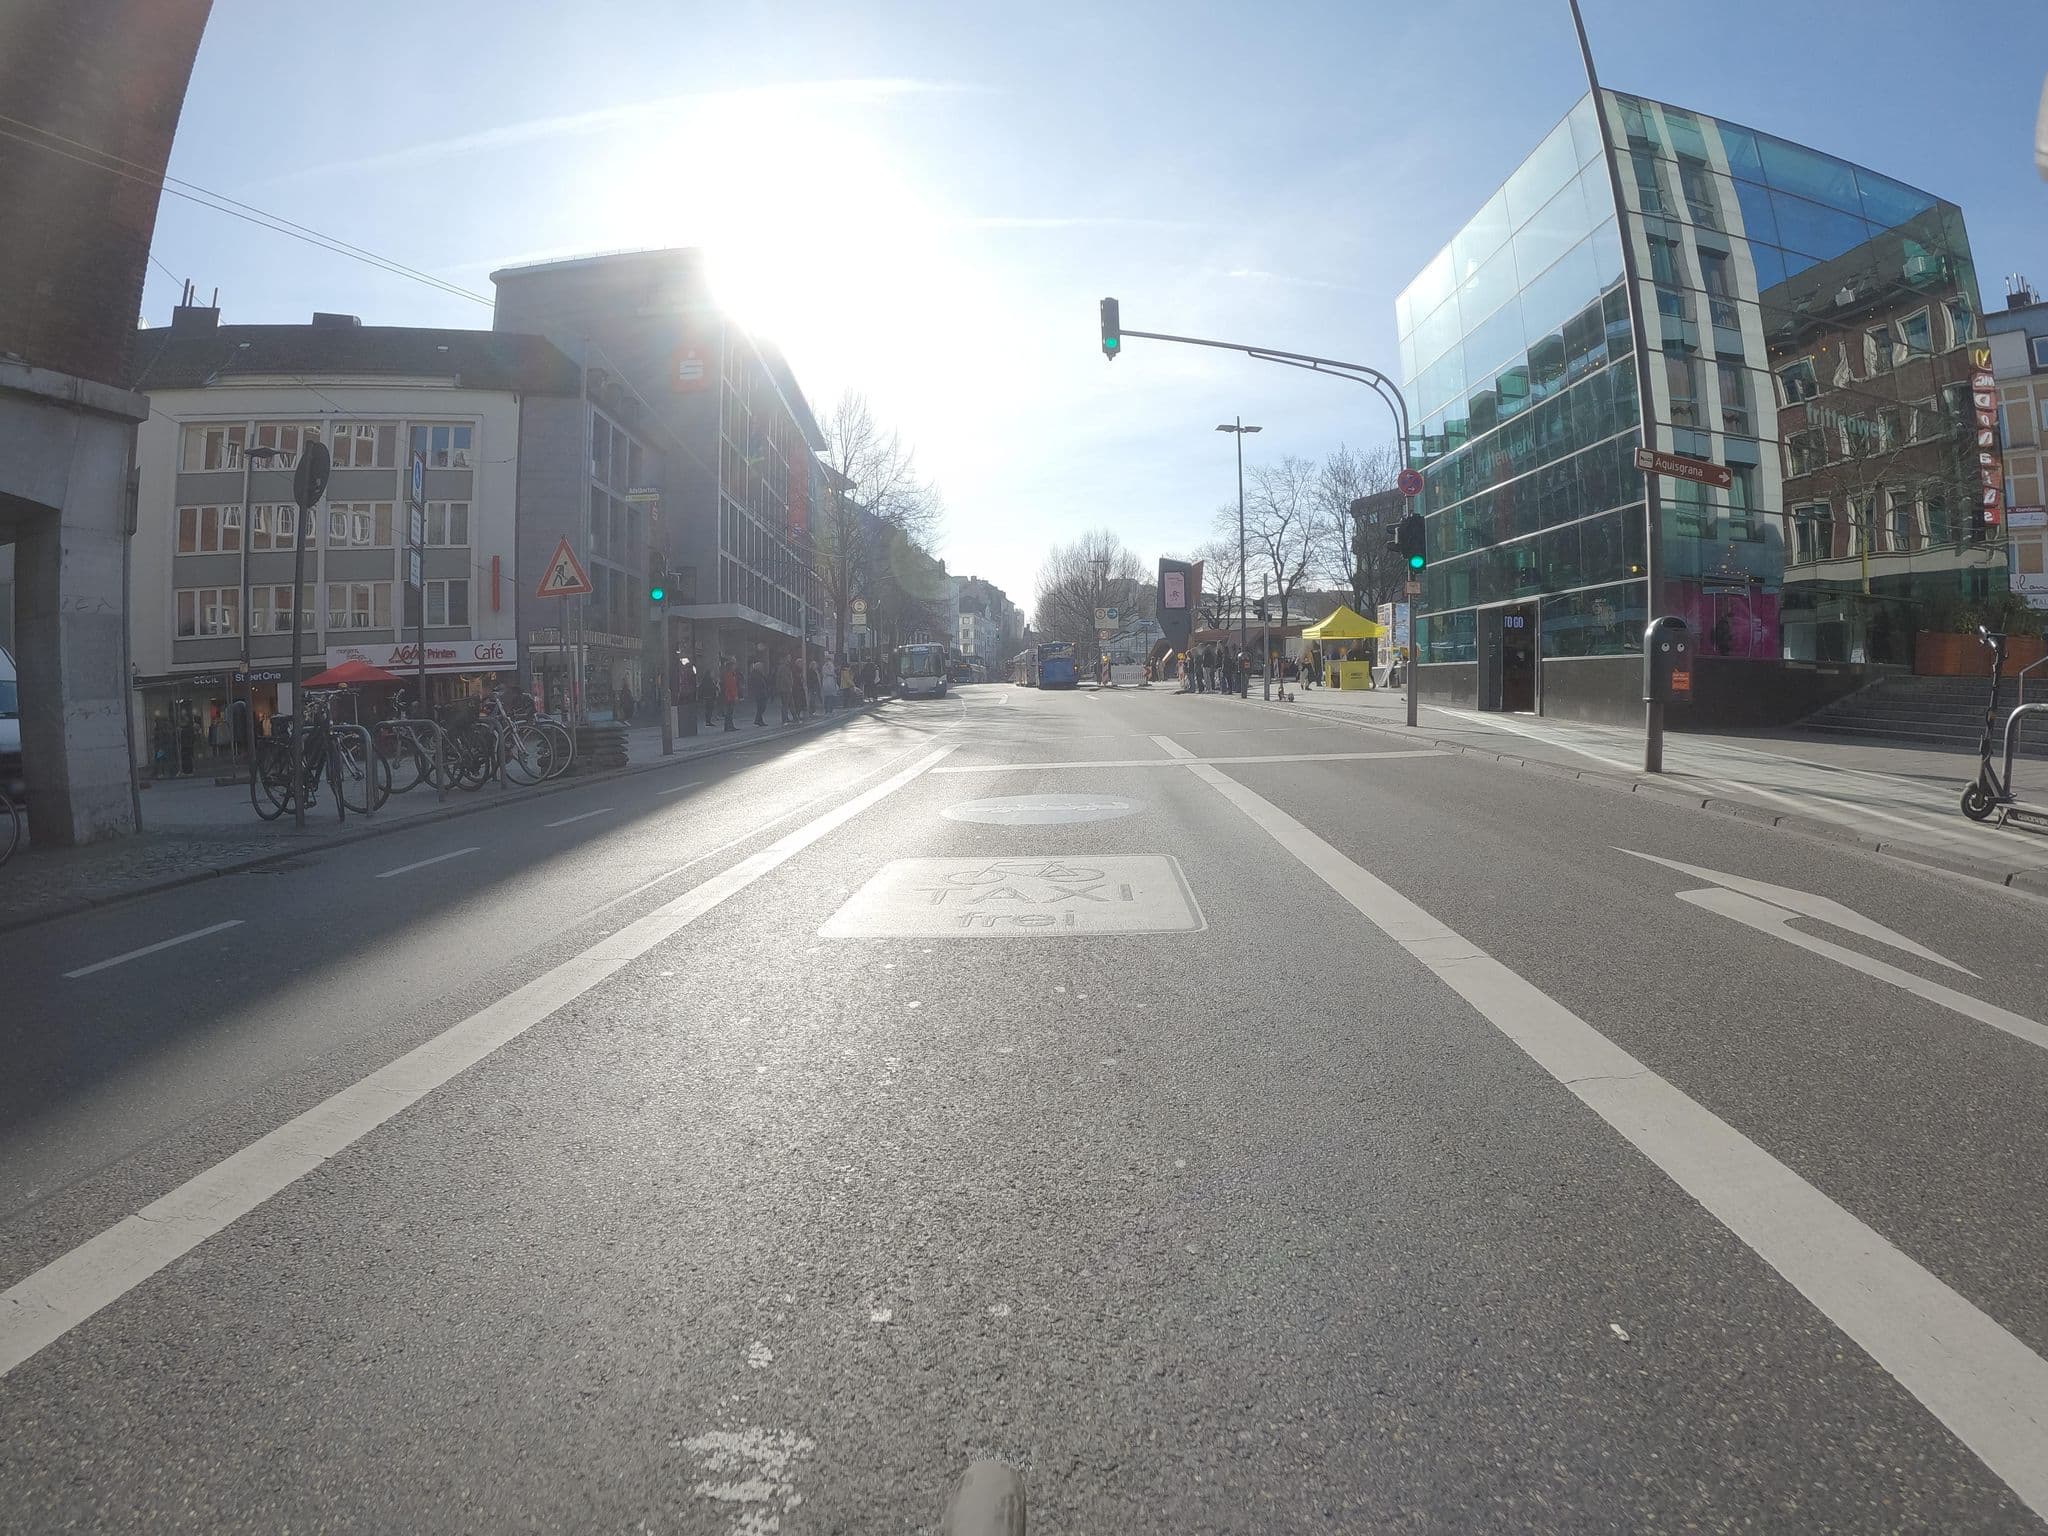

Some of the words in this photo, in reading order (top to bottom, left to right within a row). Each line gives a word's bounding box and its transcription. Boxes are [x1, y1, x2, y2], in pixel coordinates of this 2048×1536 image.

[1654, 457, 1704, 477] Aquisgrana
[1513, 616, 1524, 628] GO
[427, 648, 457, 659] Printen
[474, 642, 503, 661] Café
[262, 671, 281, 680] One
[910, 884, 1134, 905] TAXI
[957, 910, 1075, 927] frei
